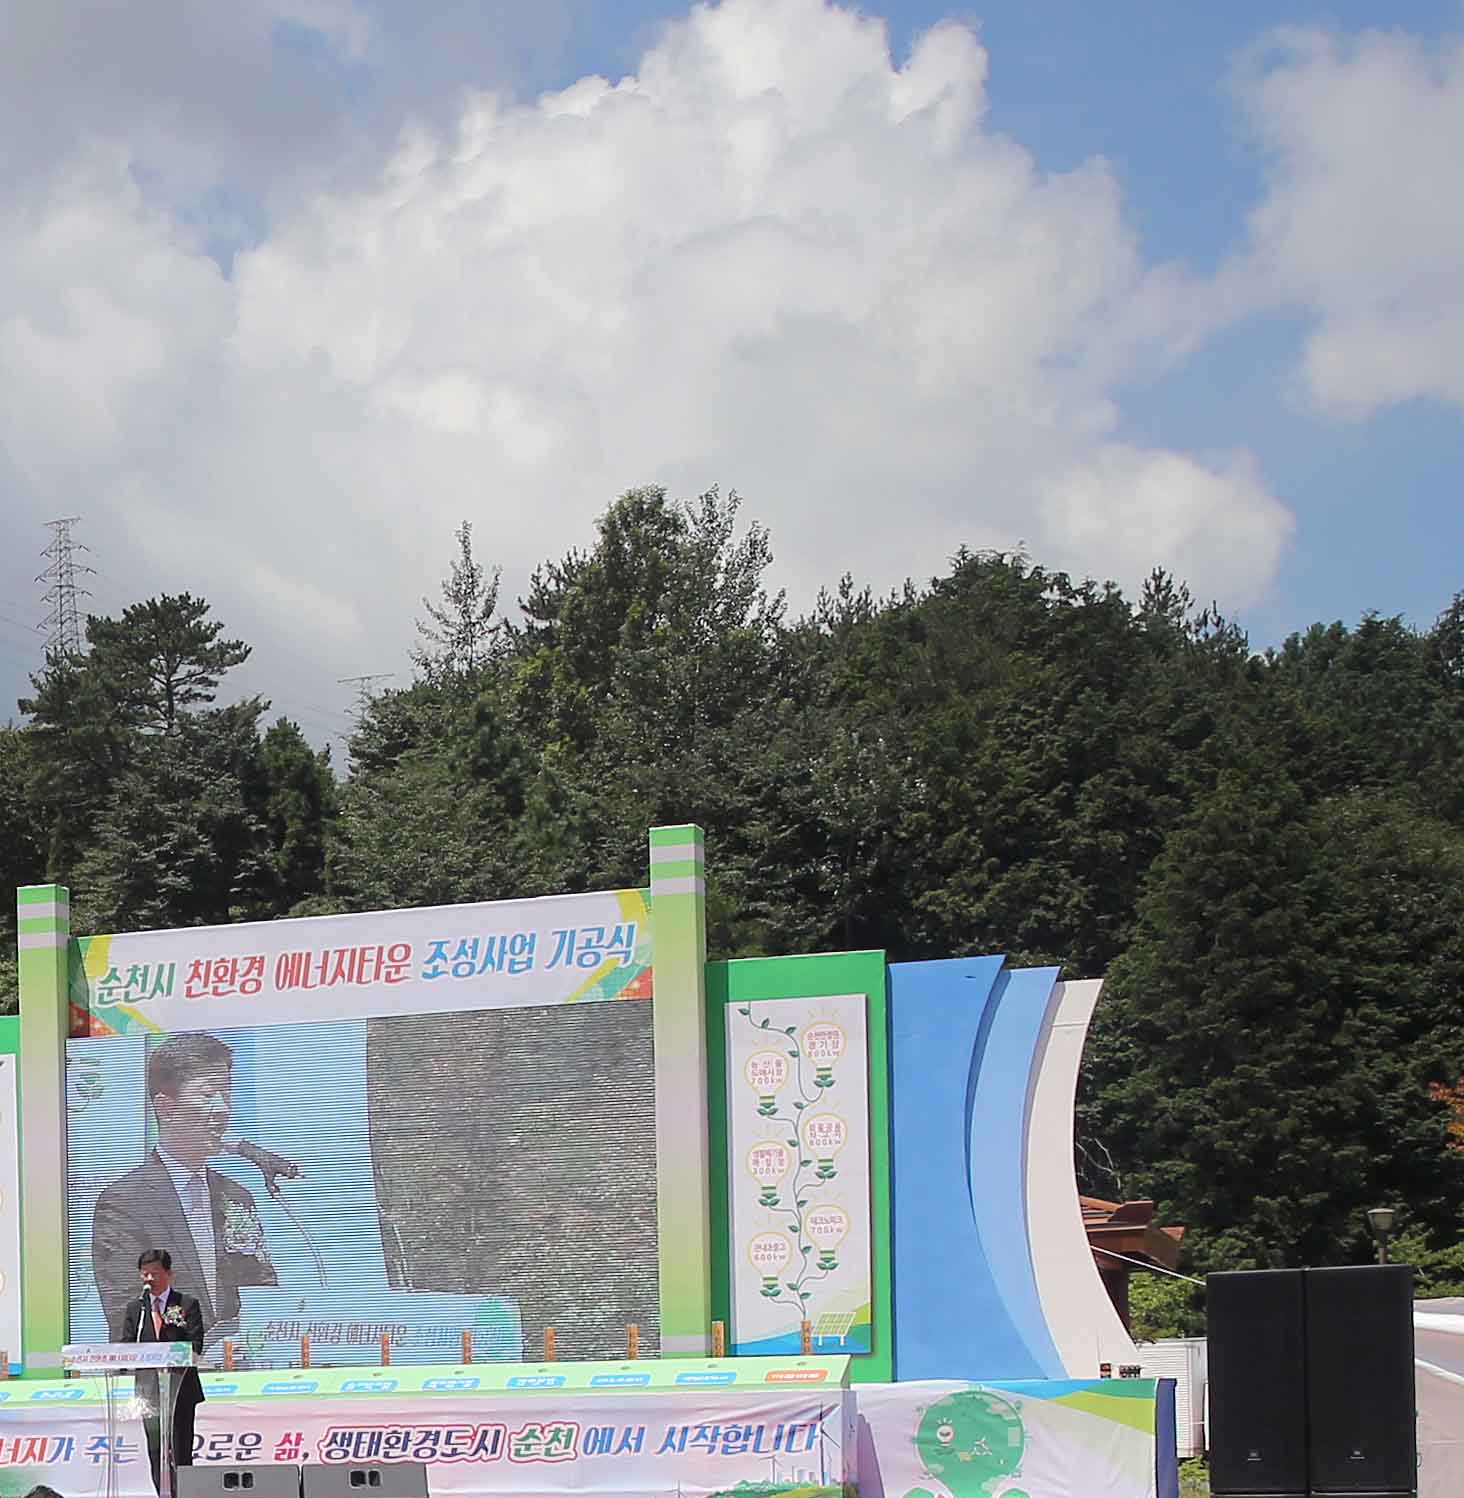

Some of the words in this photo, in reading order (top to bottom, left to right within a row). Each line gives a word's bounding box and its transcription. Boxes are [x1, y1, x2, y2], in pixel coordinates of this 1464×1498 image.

[97, 963, 175, 1004] 순천시
[185, 955, 265, 998] 친환경
[275, 943, 412, 991] 에너지타운
[422, 932, 537, 980] 조성사업
[545, 923, 636, 969] 기공식
[83, 1435, 139, 1464] 주는
[273, 1431, 309, 1462] 삶,
[322, 1426, 501, 1459] 생태환경도시
[513, 1423, 574, 1458] 순천
[582, 1425, 646, 1456] 에서
[654, 1422, 821, 1456] 시작합니다
